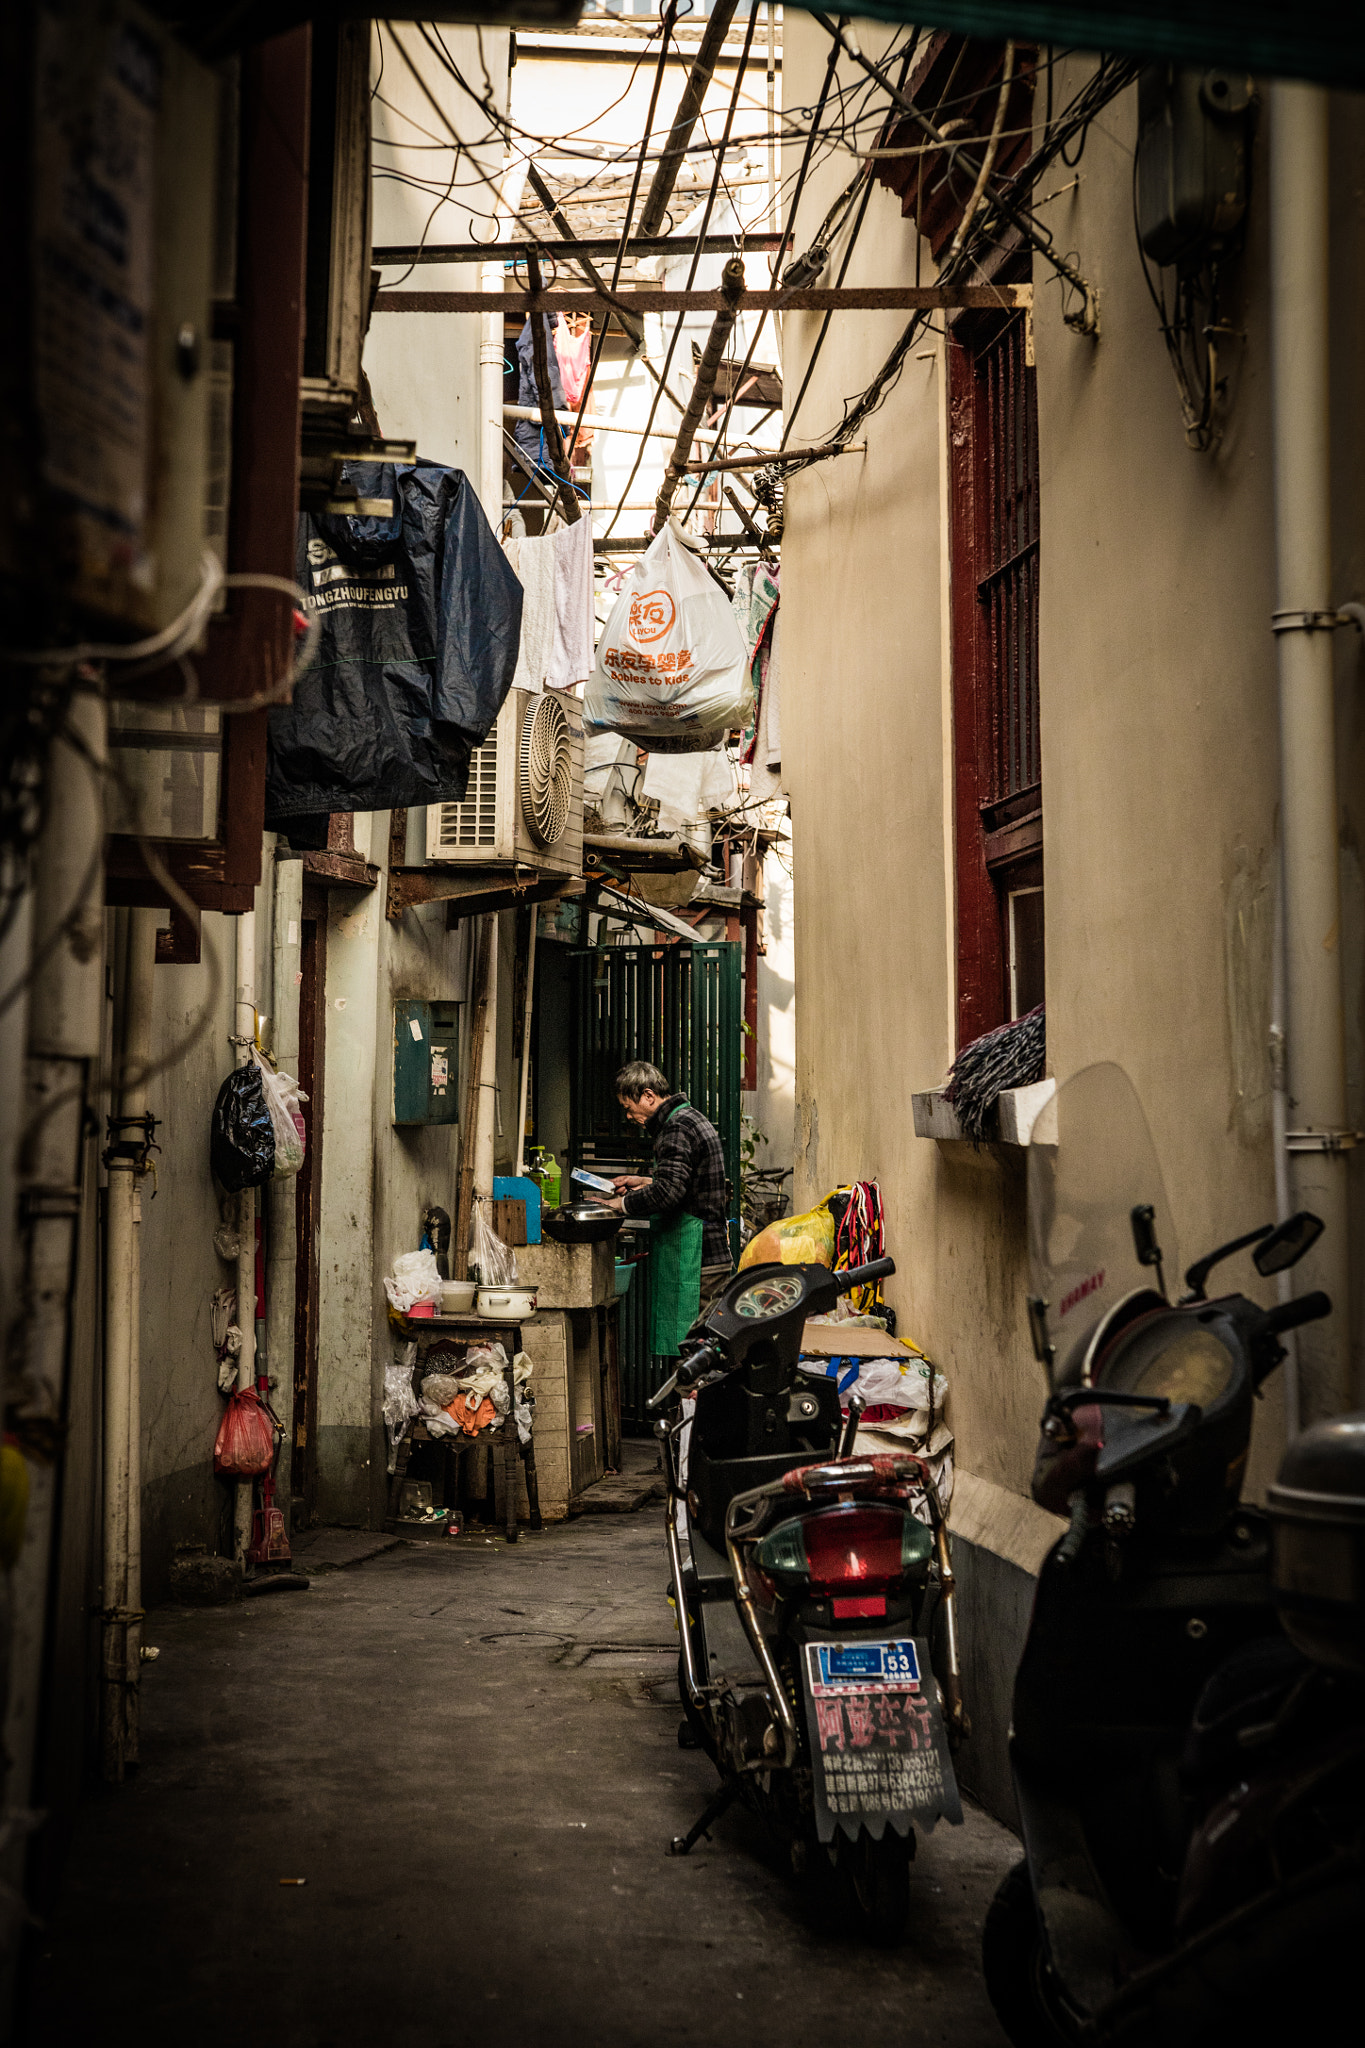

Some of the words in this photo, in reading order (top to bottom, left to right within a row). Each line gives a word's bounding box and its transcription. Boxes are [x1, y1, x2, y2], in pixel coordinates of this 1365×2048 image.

[300, 586, 408, 611] TONGZHOUFENGYU
[605, 648, 694, 673] 乐友孕婴童
[611, 671, 646, 684] Babies
[648, 676, 662, 686] to
[665, 674, 689, 686] Kids
[887, 1655, 910, 1671] 53
